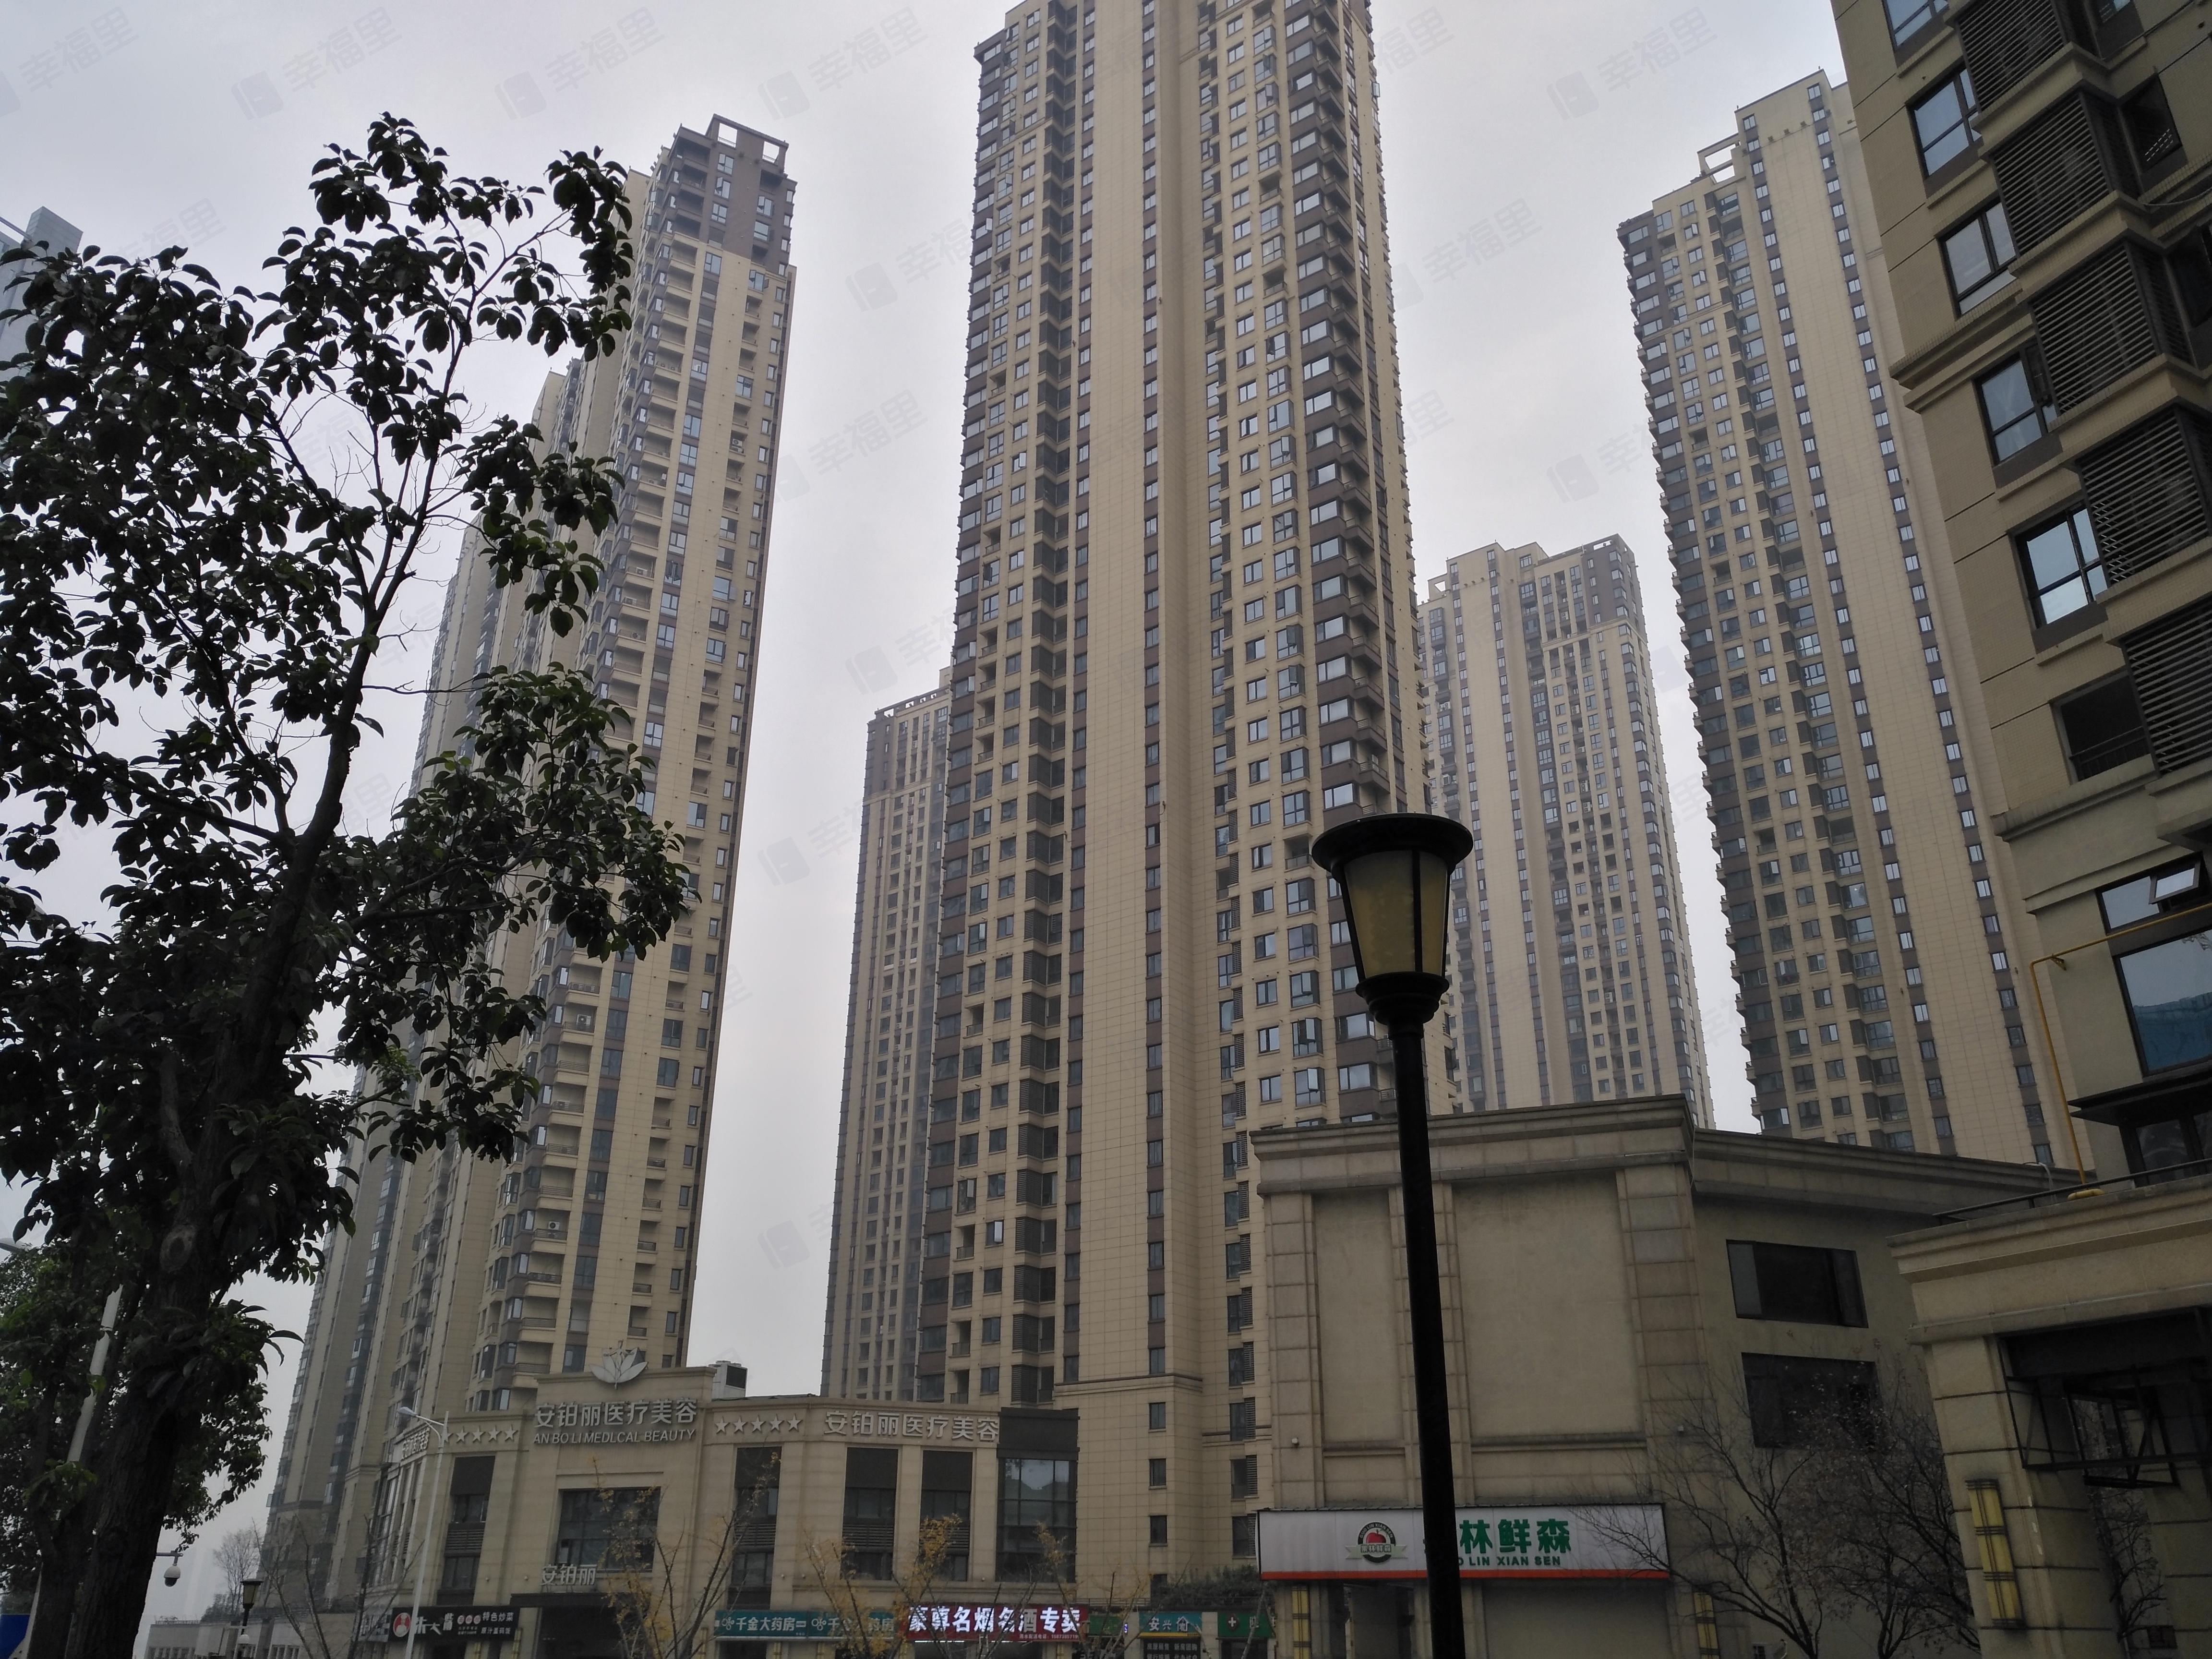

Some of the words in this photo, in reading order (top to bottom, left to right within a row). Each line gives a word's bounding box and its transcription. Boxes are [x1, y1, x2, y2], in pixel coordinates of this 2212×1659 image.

[534, 1397, 697, 1429] 安铂丽医疗美容
[824, 1410, 999, 1443] 安铂丽医疗美容
[533, 1433, 550, 1444] AN
[552, 1432, 569, 1444] BO
[572, 1433, 581, 1443] LI
[644, 1429, 696, 1442] BEAUTY
[1459, 1518, 1572, 1554] 林鲜森
[1360, 1544, 1392, 1553] 果林鲜森
[1469, 1556, 1490, 1566] LIN
[1497, 1556, 1529, 1566] XIAN
[1534, 1556, 1561, 1566] SEN
[540, 1563, 597, 1586] 安铂丽
[482, 1611, 514, 1622] 特色炒菜
[736, 1616, 795, 1632] 千金大药房
